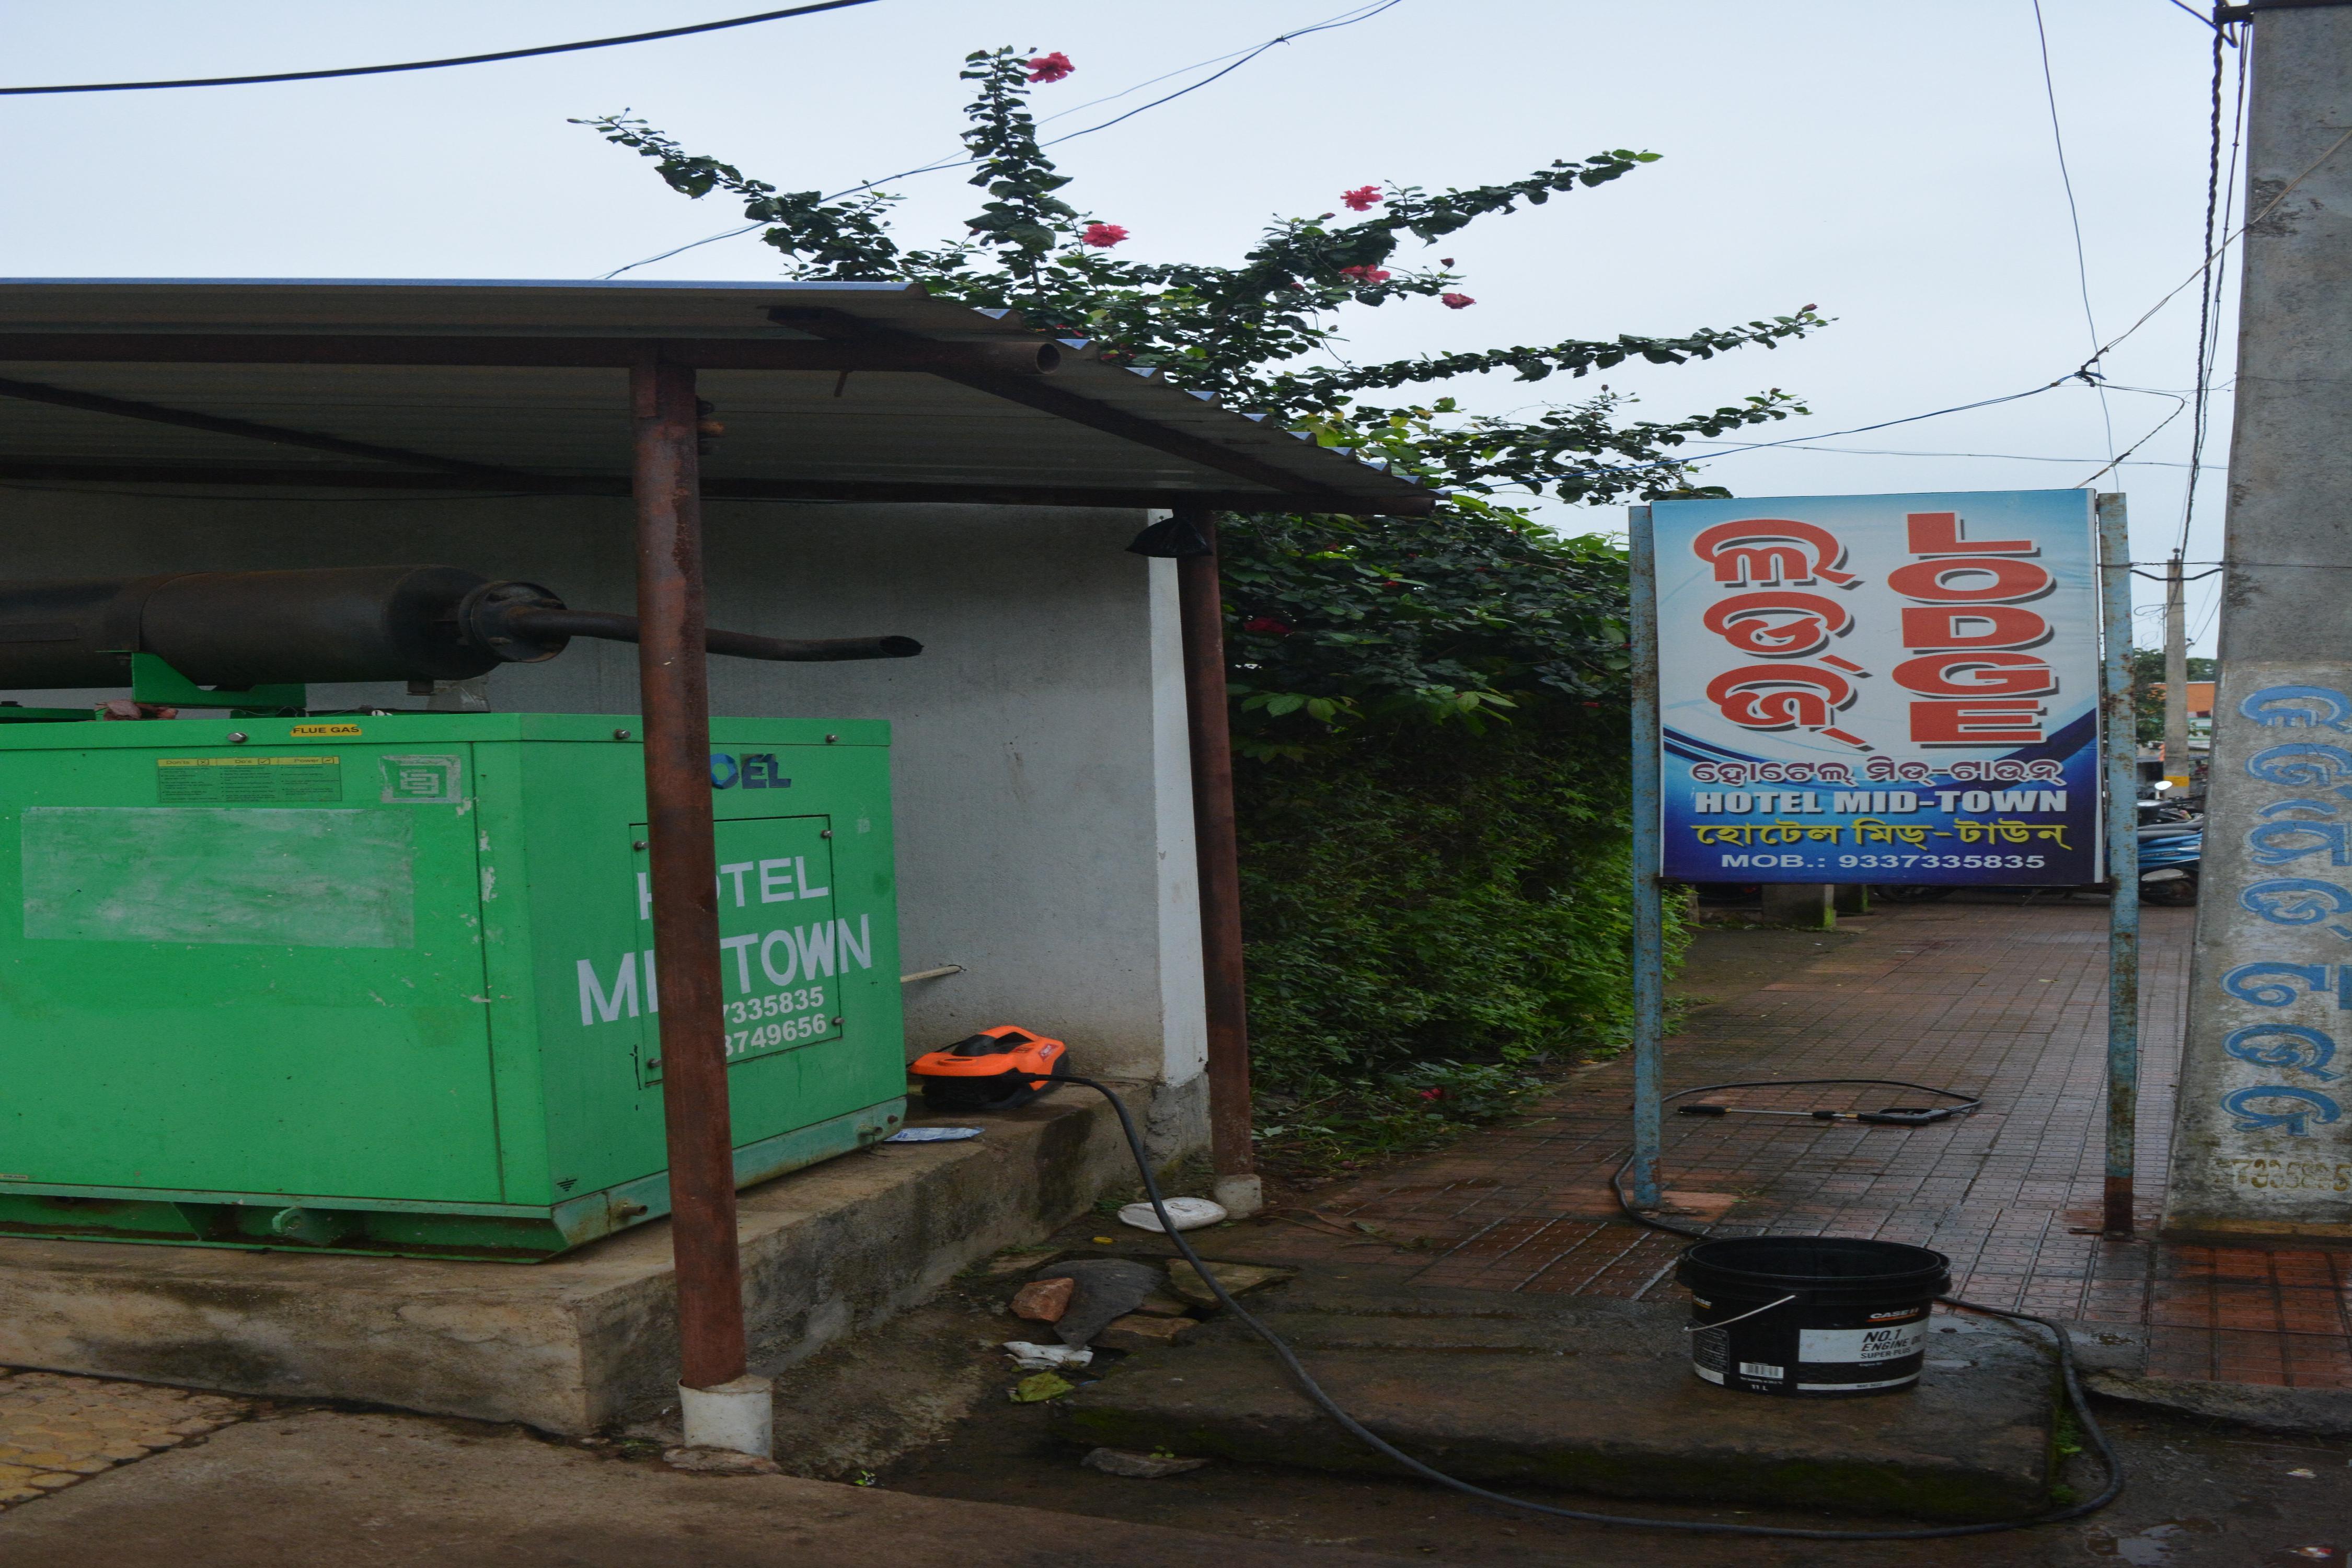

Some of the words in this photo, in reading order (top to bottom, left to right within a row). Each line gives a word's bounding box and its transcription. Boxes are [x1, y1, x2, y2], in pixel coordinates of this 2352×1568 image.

[1888, 512, 2050, 742] LODGE
[710, 754, 792, 789] OEL
[1696, 791, 1822, 812] HOTEL
[1834, 790, 2067, 813] MID-TOWN
[1690, 818, 1843, 847] হোটেল
[1722, 855, 1825, 867] MOB.:
[1839, 855, 2045, 868] 9337335835
[576, 949, 658, 1026] MI
[720, 986, 824, 1023] 335835
[1870, 1309, 1910, 1319] CASE
[1861, 1338, 1909, 1352] ENGINE
[1863, 1329, 1902, 1343] NO.1
[1894, 1347, 1911, 1356] PLUS
